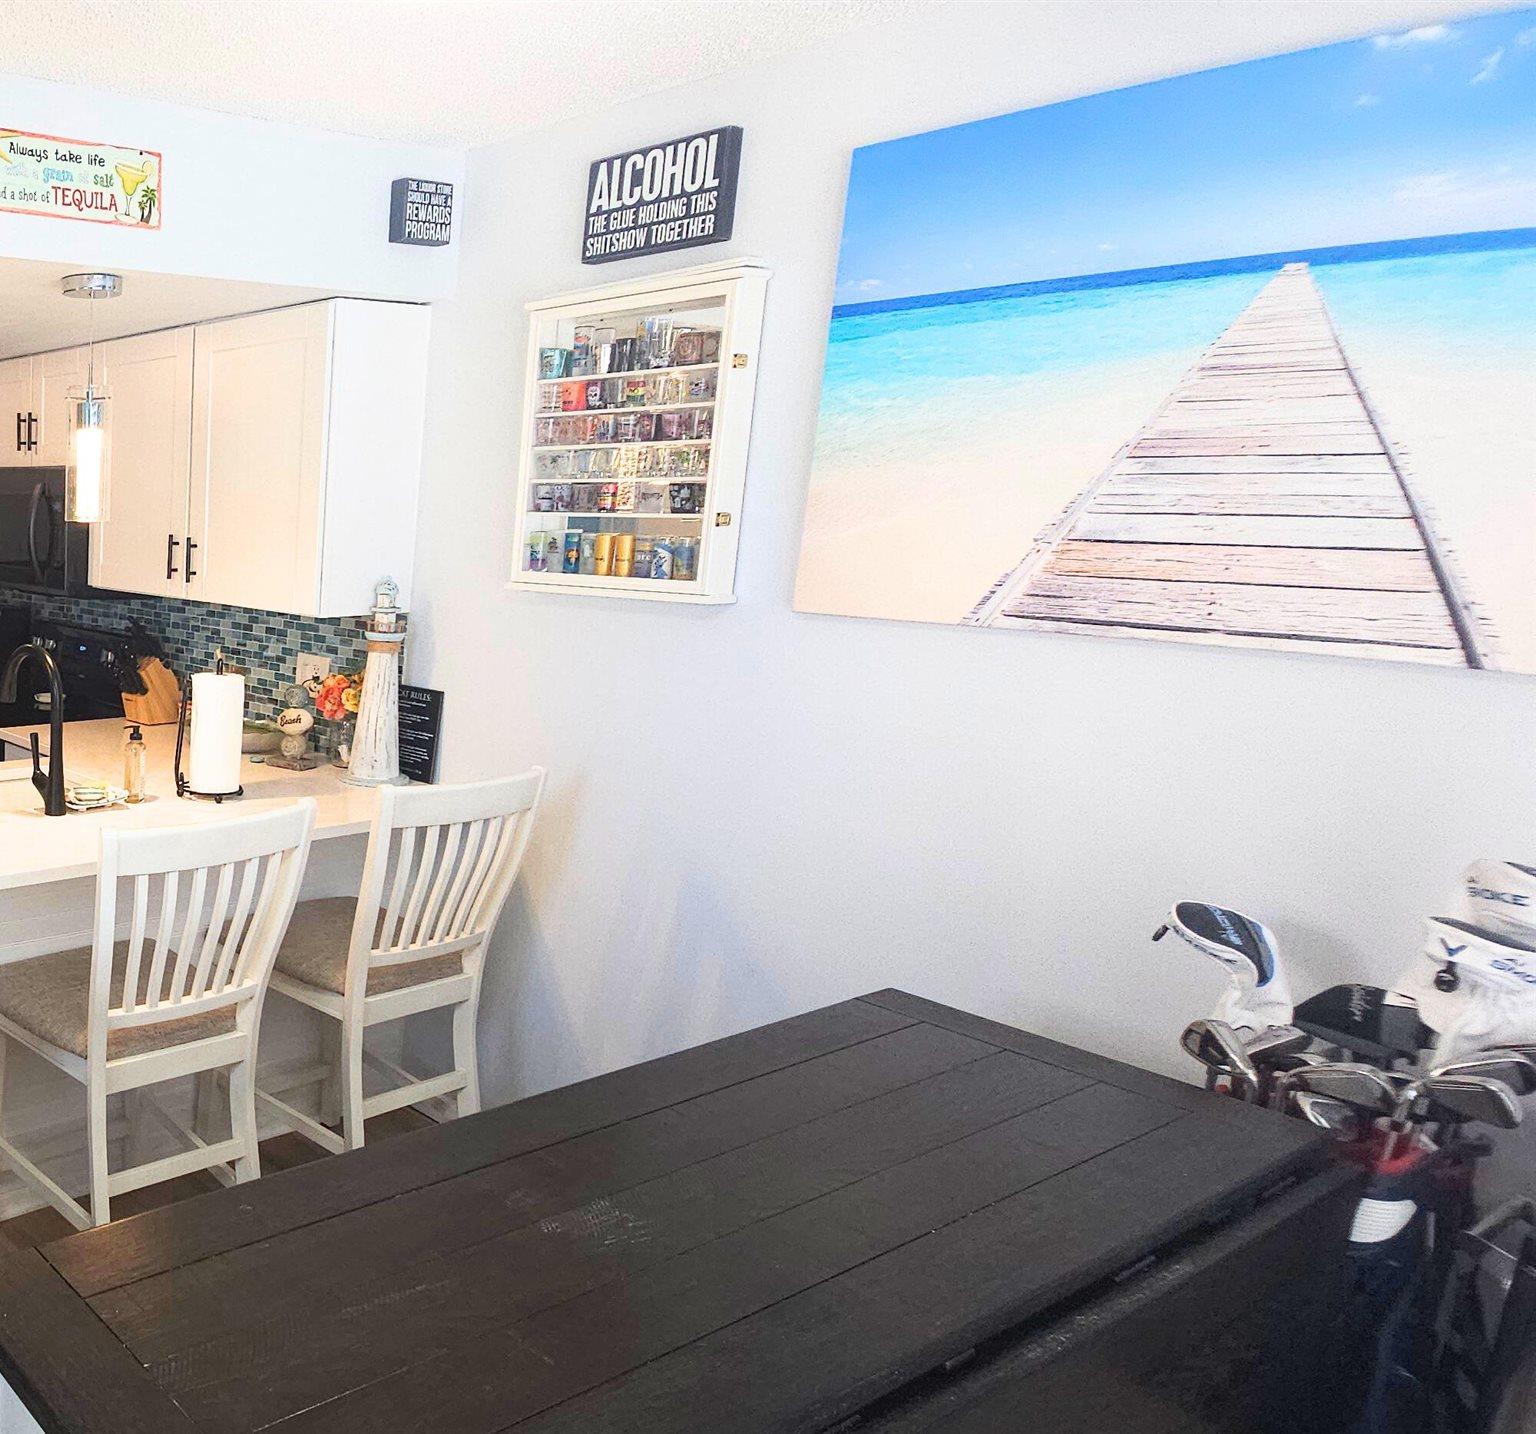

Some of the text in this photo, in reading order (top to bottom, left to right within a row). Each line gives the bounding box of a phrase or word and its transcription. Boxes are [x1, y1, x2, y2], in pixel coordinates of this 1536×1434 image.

[9, 142, 106, 167] Always take life
[93, 173, 114, 188] salt
[589, 134, 719, 214] ALCOHOL
[10, 191, 15, 200] a
[18, 188, 37, 202] shot
[41, 191, 50, 204] of
[51, 186, 118, 213] TEQUILA
[430, 193, 446, 206] HAVE
[447, 196, 452, 207] A
[406, 203, 451, 224] REWARDS
[588, 191, 717, 236] THE GLUE HOLDING THIS
[405, 221, 450, 242] PROGRAM
[585, 214, 715, 257] SHITSHOW TOGETHER
[280, 714, 302, 727] Beach
